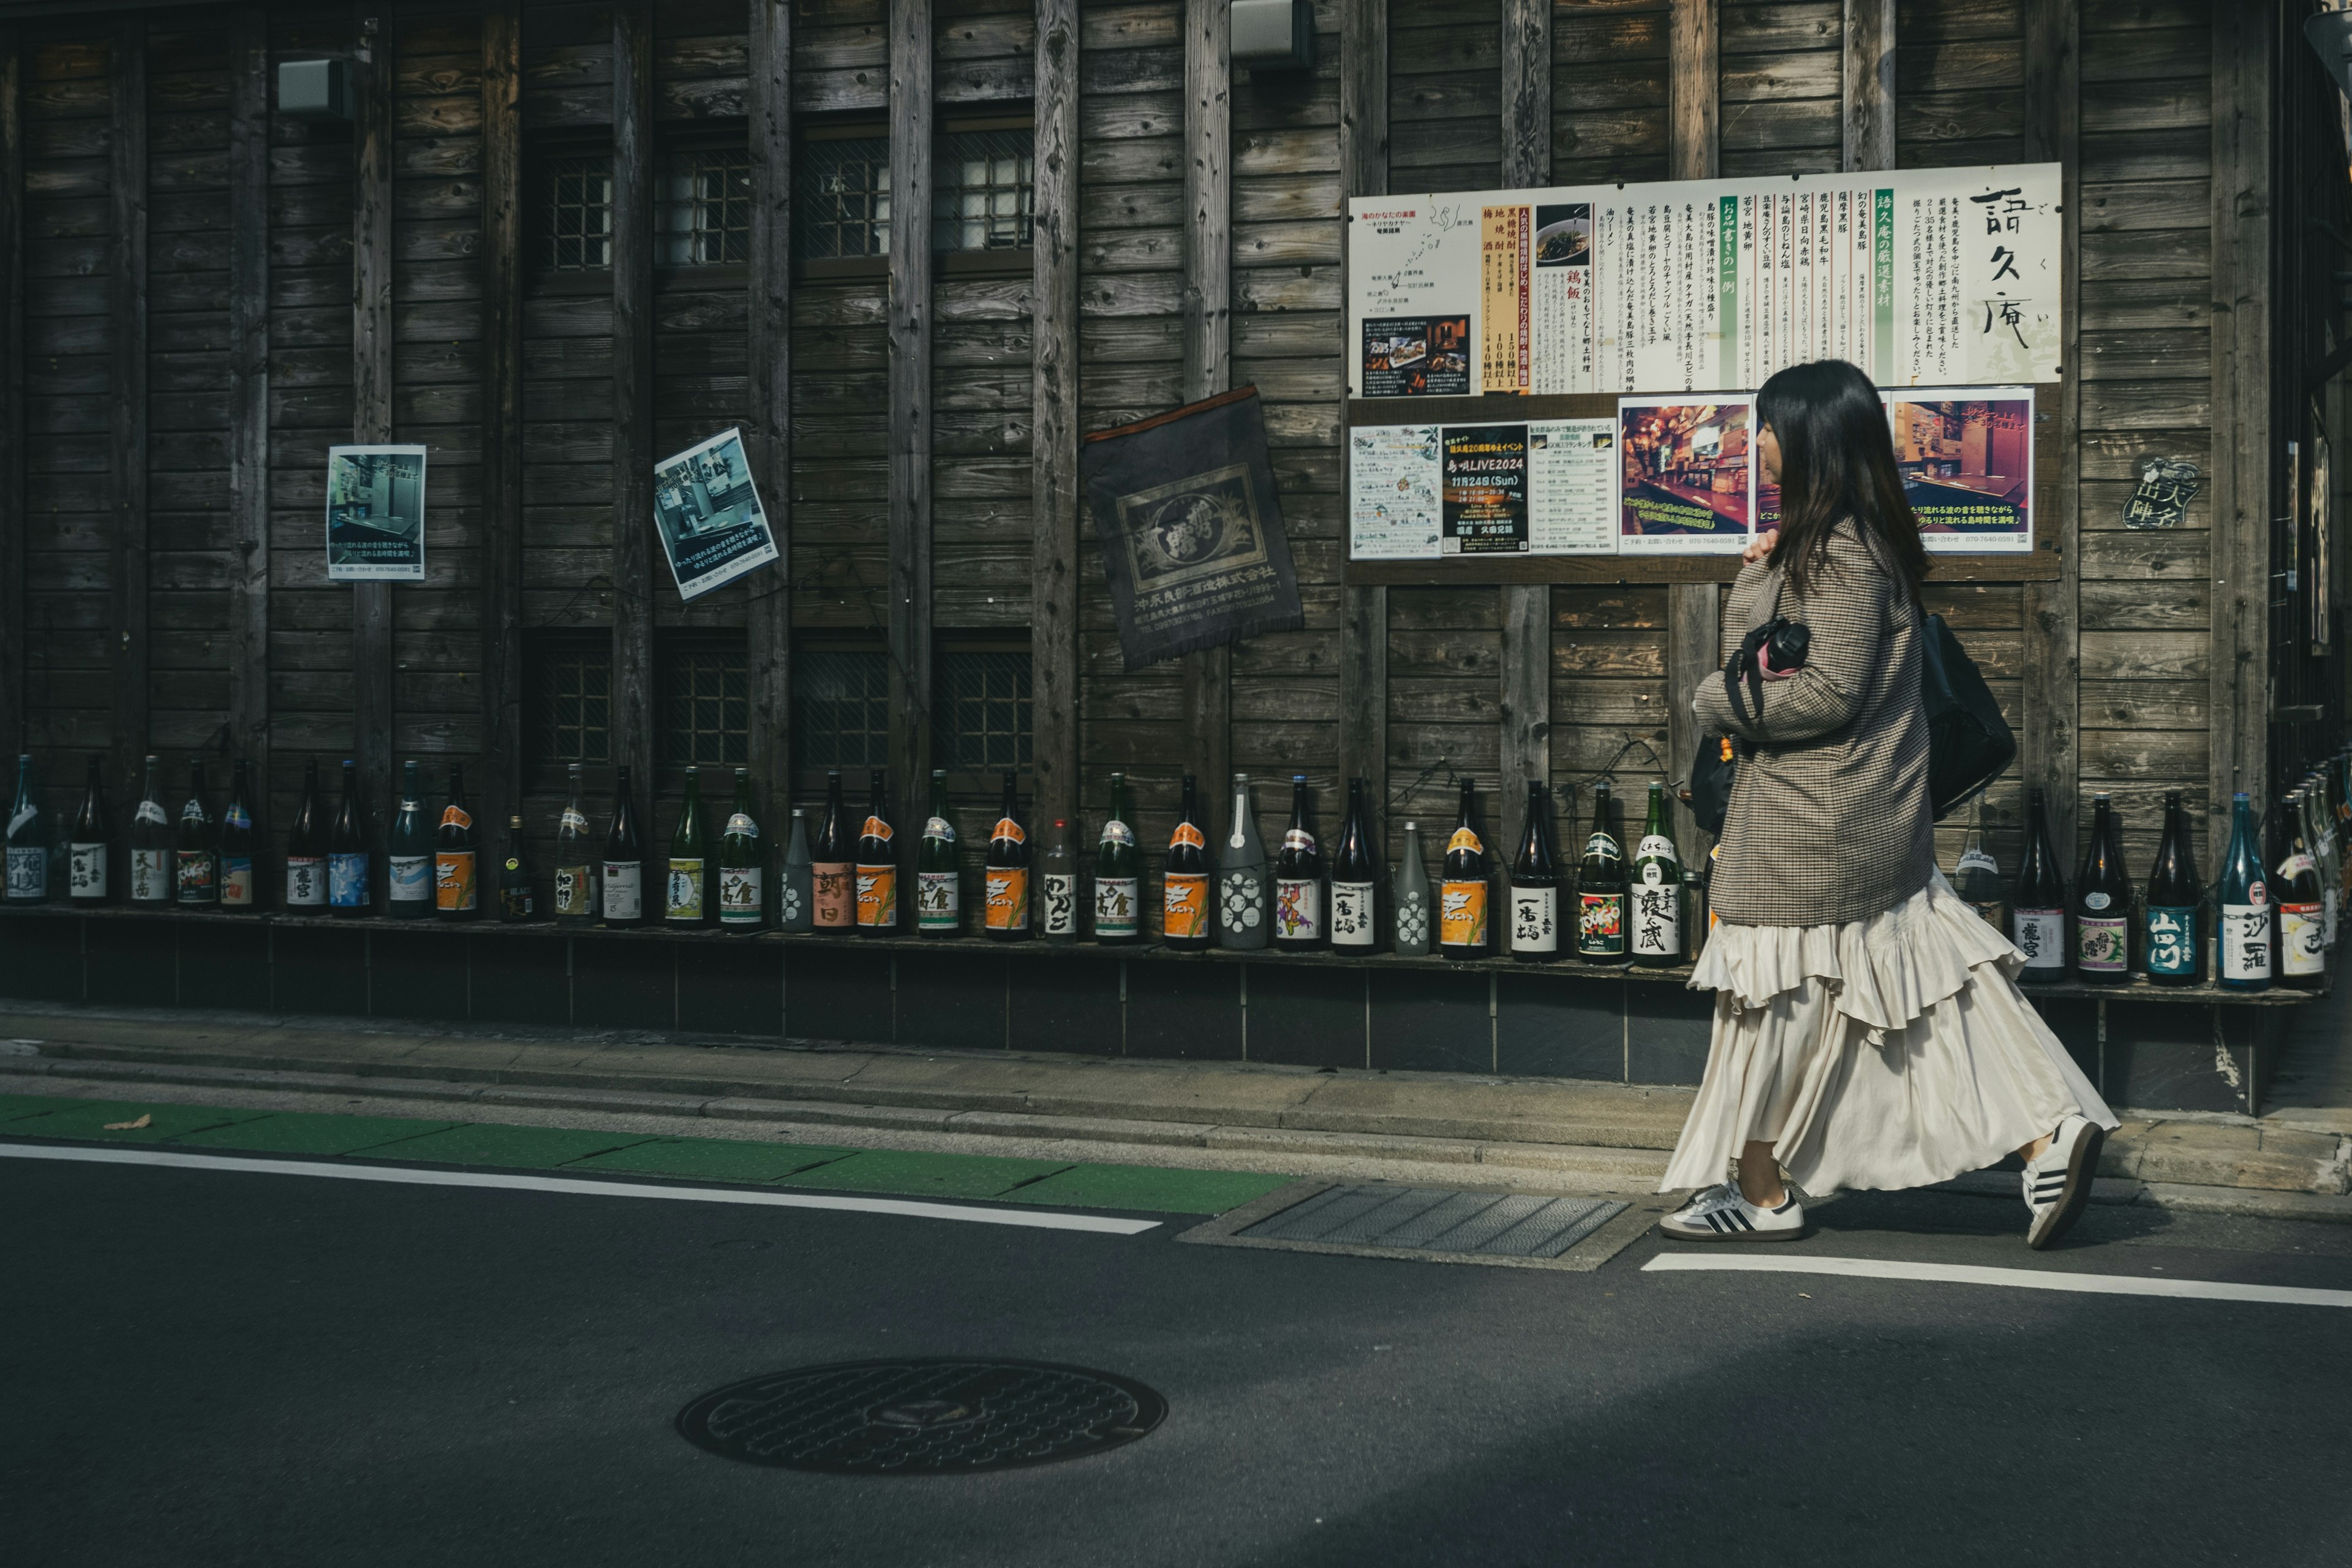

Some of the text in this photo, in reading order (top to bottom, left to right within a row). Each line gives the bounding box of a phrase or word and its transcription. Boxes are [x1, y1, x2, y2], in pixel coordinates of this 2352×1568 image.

[1362, 211, 1416, 219] 海のかなたの楽園
[1744, 196, 1752, 216] 若宮
[1838, 192, 1848, 233] 薩摩黒豚
[1857, 192, 1867, 250] 幻の奄美島豚
[1507, 208, 1516, 249] 黒糖焼酎
[1685, 204, 1694, 280] 奄美大島住用村産
[1722, 203, 1736, 293] お品書きの一例
[1743, 221, 1752, 251] 地黄卵
[1781, 195, 1790, 268] 与論島のじねん塩
[1800, 194, 1810, 266] 宮崎県日向赤鶏
[1819, 192, 1829, 266] 鹿児島黒毛和牛
[1706, 203, 1715, 320] 島豚の味噌漬け珍味3種盛り
[1877, 196, 1892, 306] 語久庵の厳選素材
[1969, 187, 2034, 349] 語久庵
[1567, 270, 1581, 300] 鶏飯
[1452, 475, 1518, 487] 11月24日(Sun)
[1134, 565, 1276, 611] 沖永良部酒造株式会社
[296, 867, 312, 899] 龍宮
[557, 870, 571, 909] 加那
[722, 882, 758, 905] 高倉
[818, 872, 842, 923] 朝日
[1097, 892, 1134, 917] 高倉
[1335, 892, 1355, 934] 一番橋
[1517, 899, 1540, 941] 一番橋
[2022, 922, 2041, 959] 龍宮
[2242, 915, 2269, 971] 沙羅
